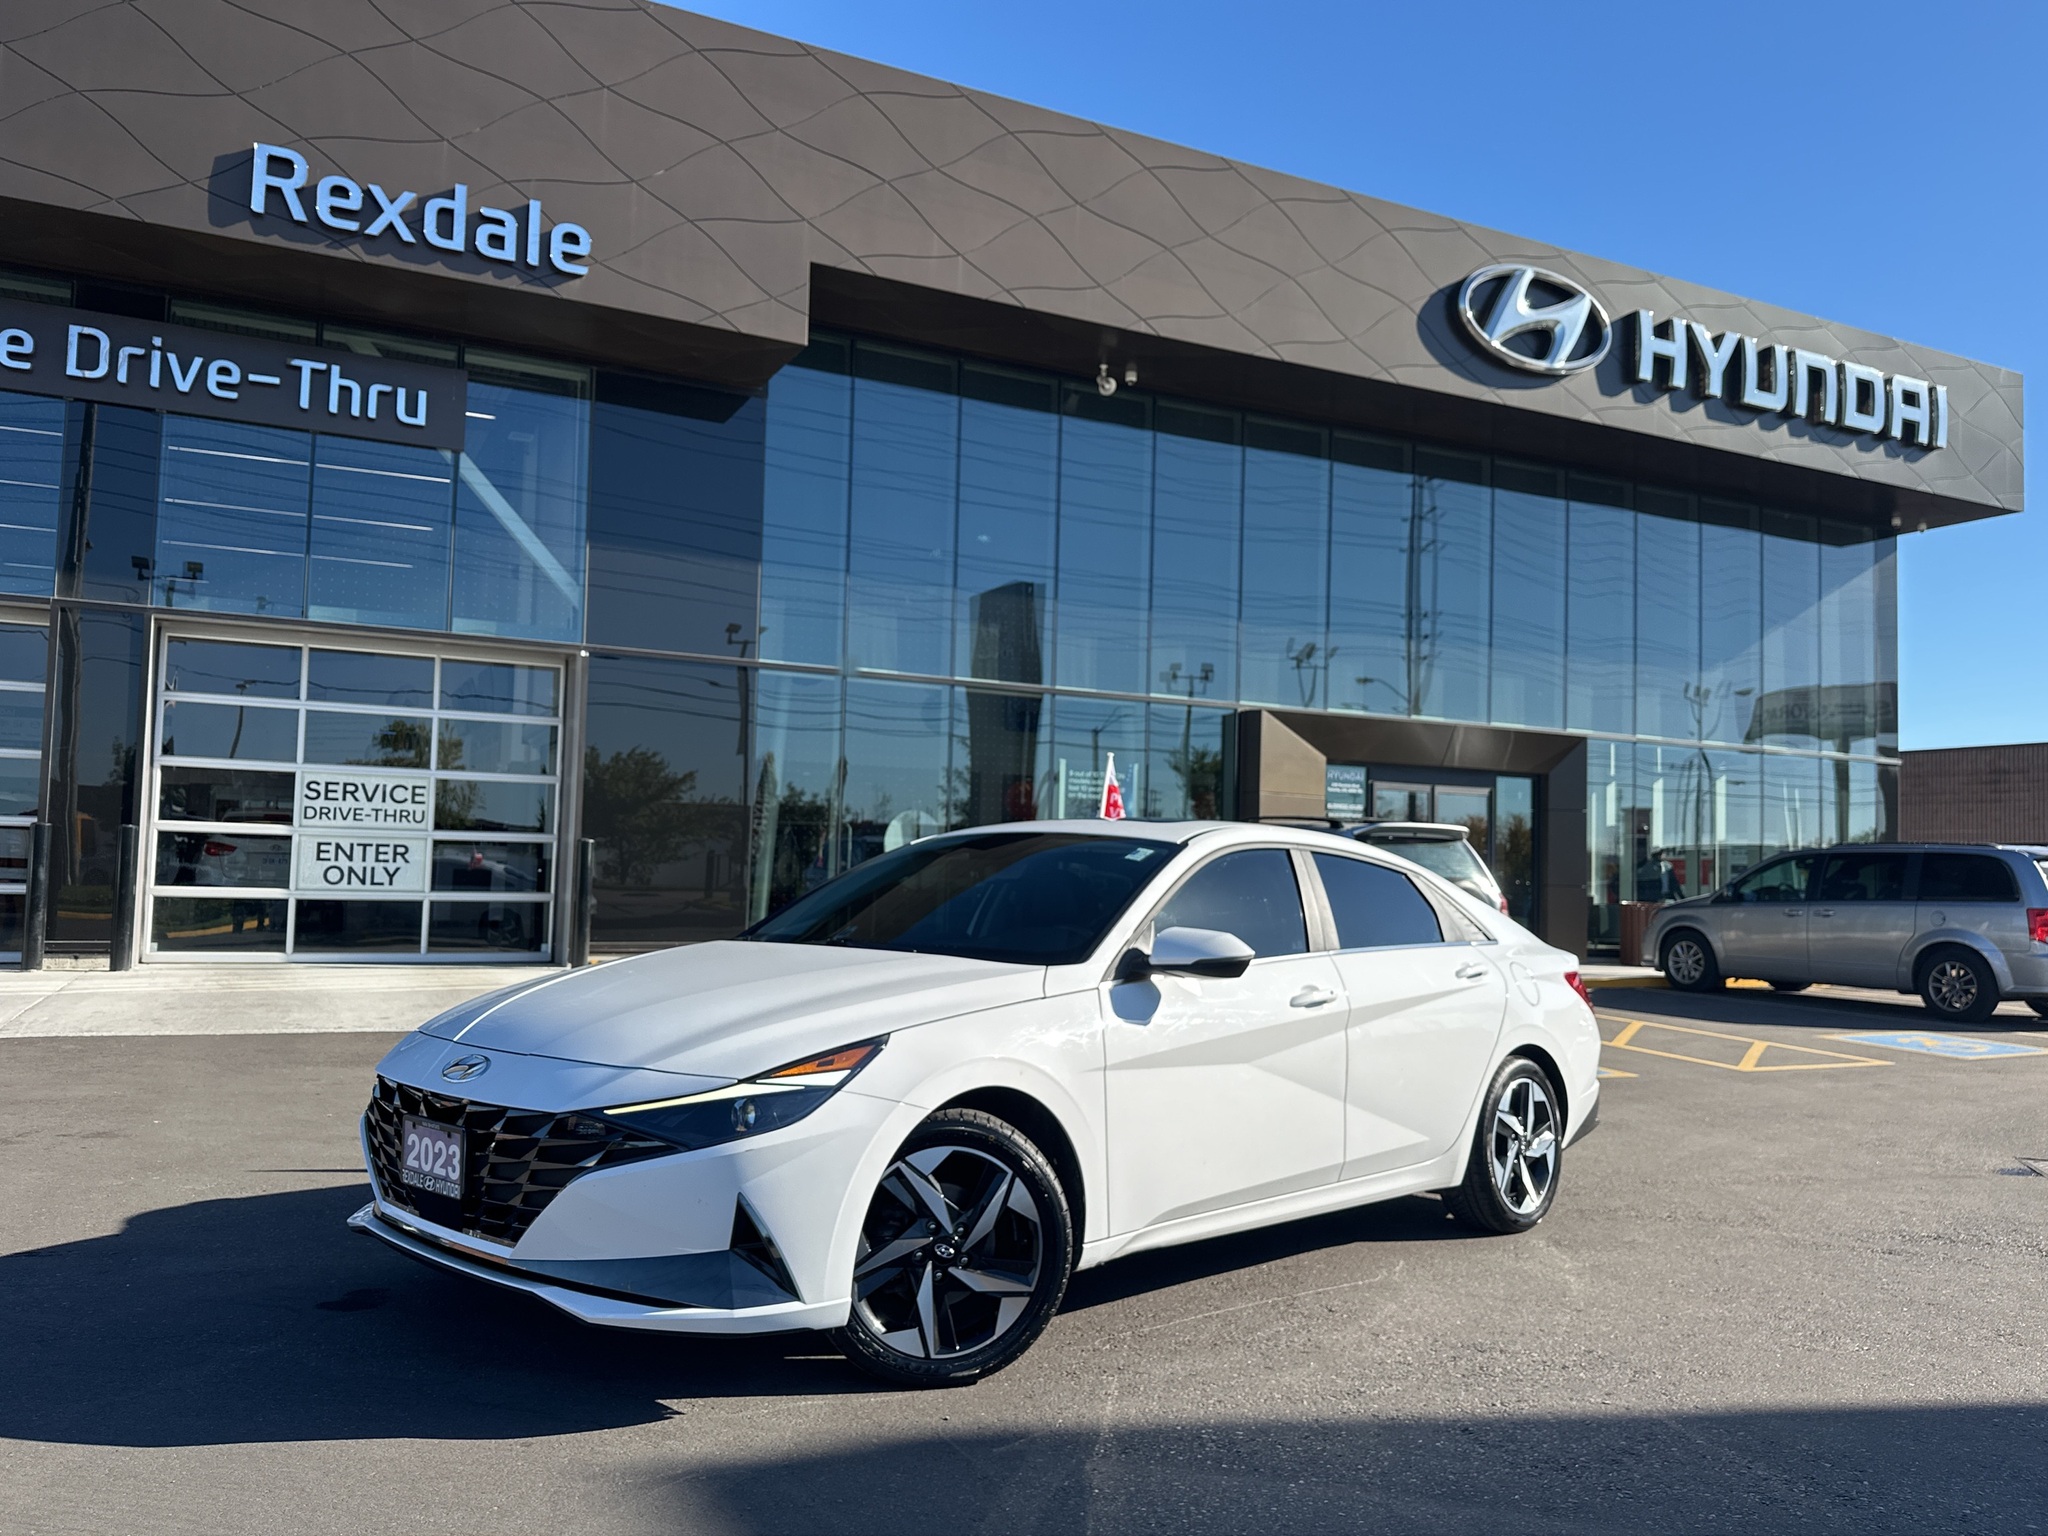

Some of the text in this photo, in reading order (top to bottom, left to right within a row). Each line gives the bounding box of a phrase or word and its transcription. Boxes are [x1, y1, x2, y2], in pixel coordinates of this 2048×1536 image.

[251, 141, 592, 276] Rexdale
[66, 324, 428, 427] Drive-Thru
[1636, 308, 1948, 449] HYUNDAI
[304, 780, 427, 805] SERVICE
[303, 805, 426, 824] DRIVE-THRU
[316, 842, 410, 863] ENTER
[323, 865, 401, 886] ONLY
[406, 1133, 461, 1180] 2023
